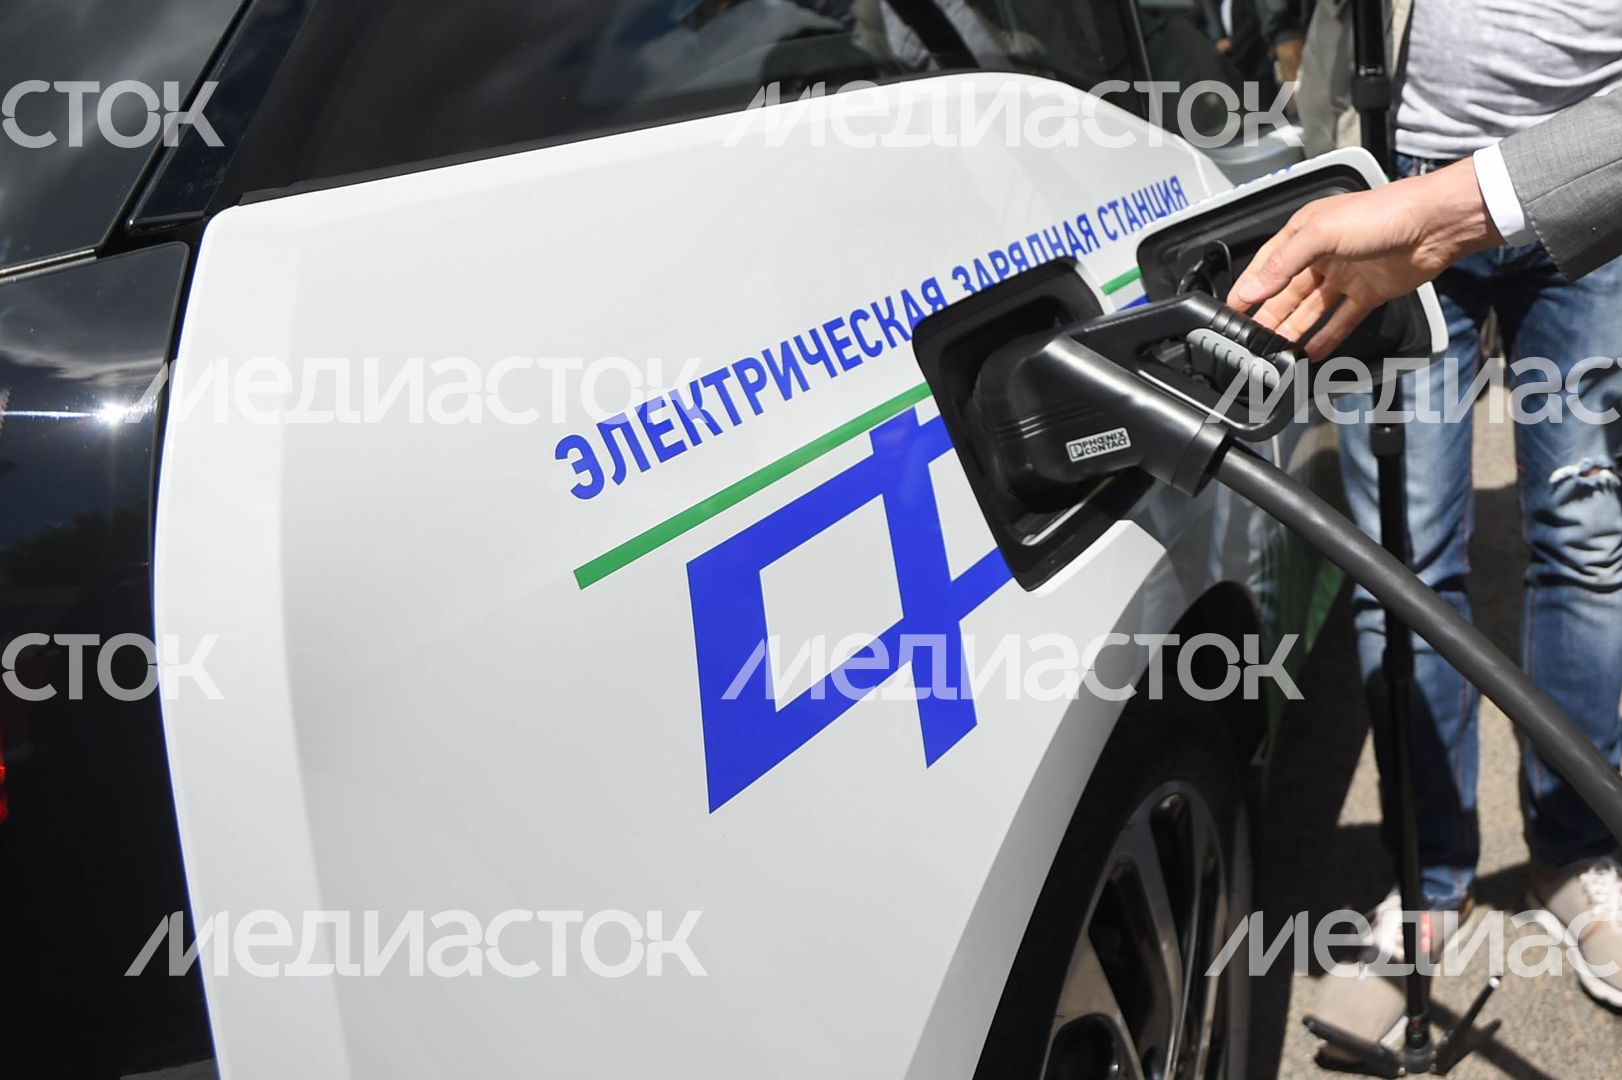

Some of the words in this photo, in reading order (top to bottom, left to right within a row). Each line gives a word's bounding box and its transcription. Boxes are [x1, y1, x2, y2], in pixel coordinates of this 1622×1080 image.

[554, 276, 948, 500] ЭЛЕКТРИЧЕСКАЯ
[1098, 175, 1190, 242] СТАНЦИЯ
[1085, 438, 1127, 455] CONTACT
